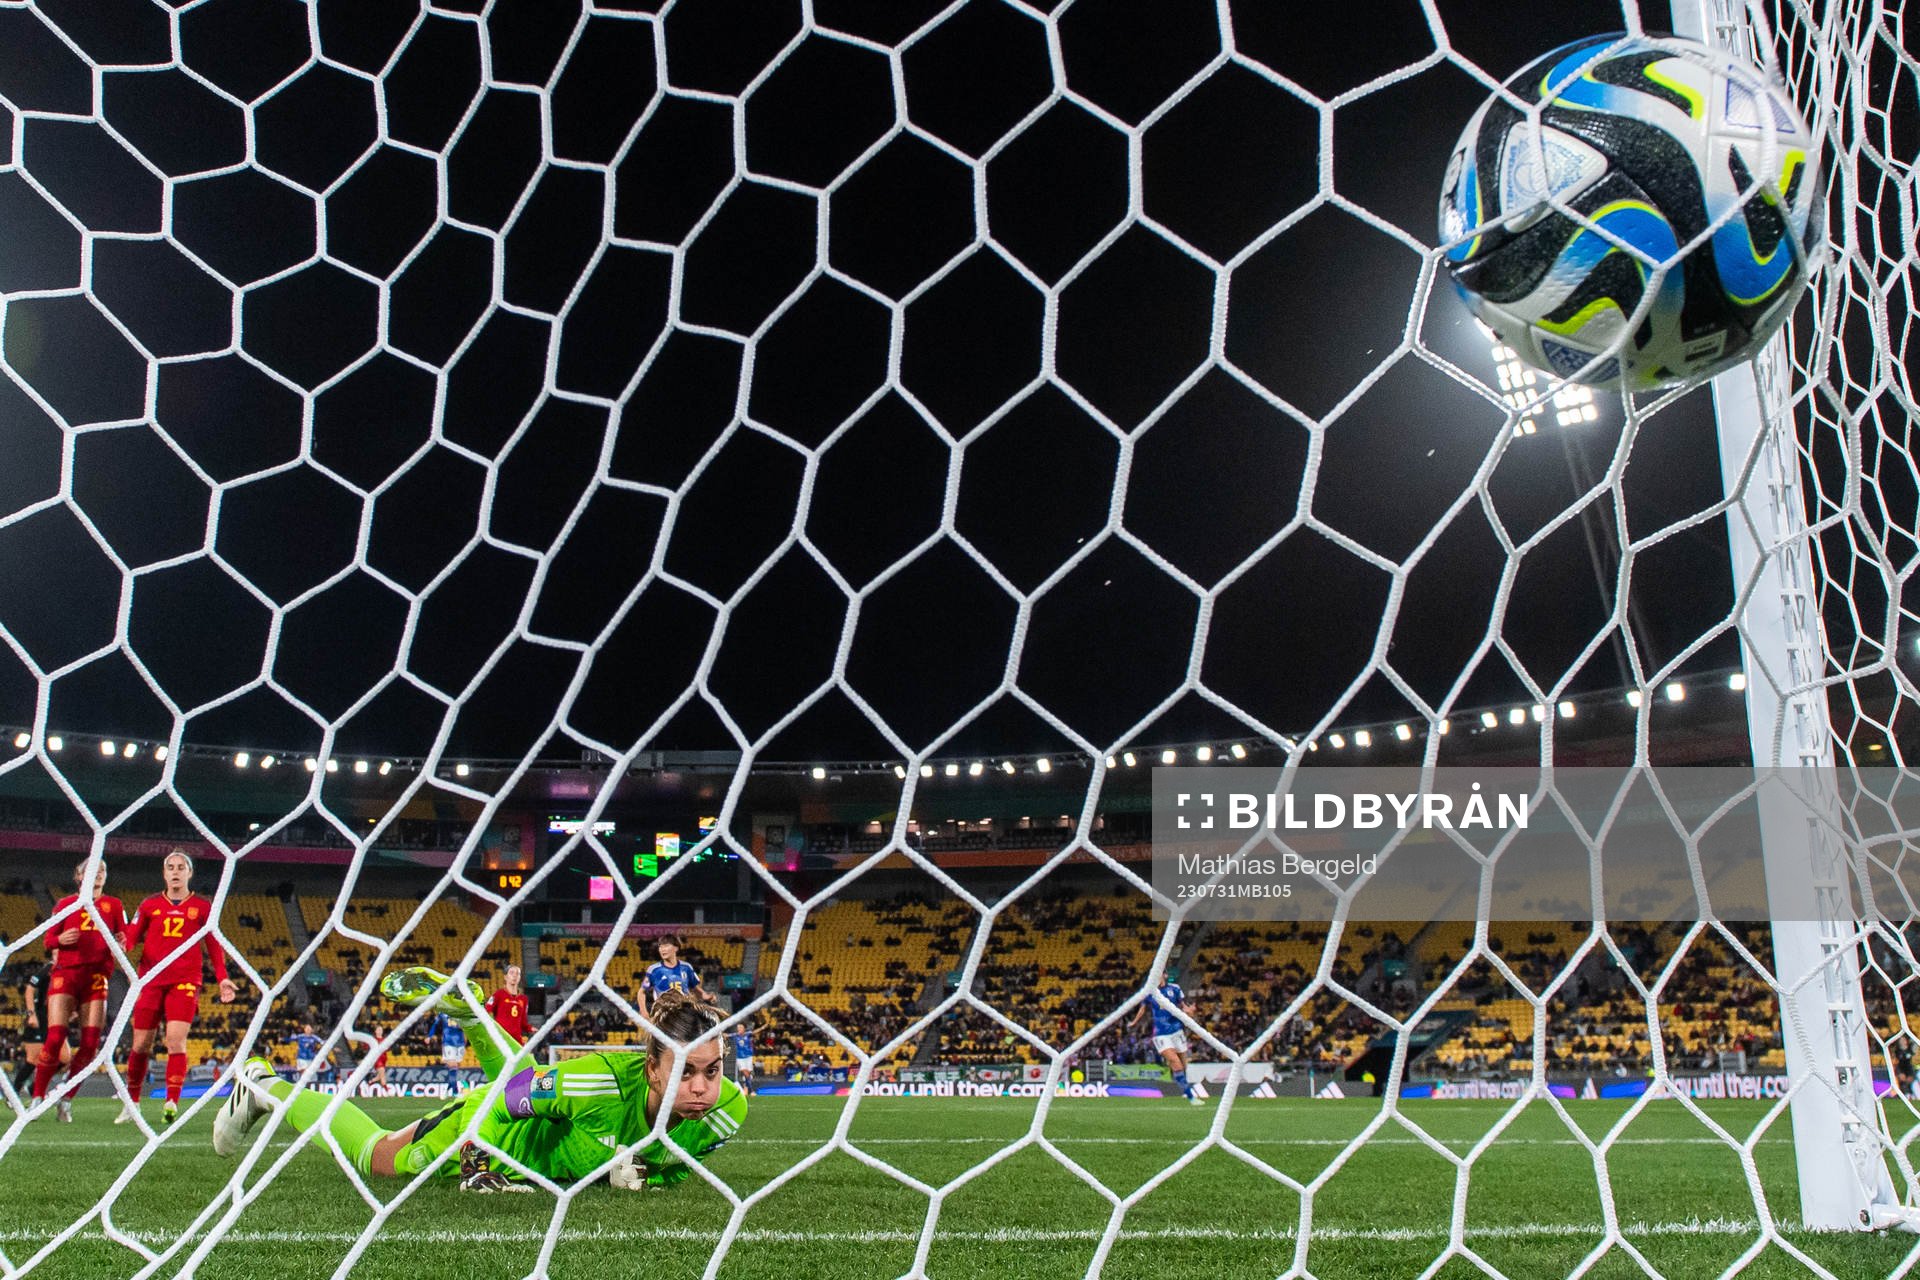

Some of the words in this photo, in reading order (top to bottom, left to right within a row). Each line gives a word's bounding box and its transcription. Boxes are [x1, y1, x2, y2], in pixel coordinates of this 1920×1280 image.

[163, 917, 185, 937] 12
[510, 1004, 519, 1017] 6
[908, 1080, 954, 1096] until
[1063, 1080, 1110, 1097] look
[1693, 1072, 1725, 1099] until
[1725, 1072, 1761, 1100] they
